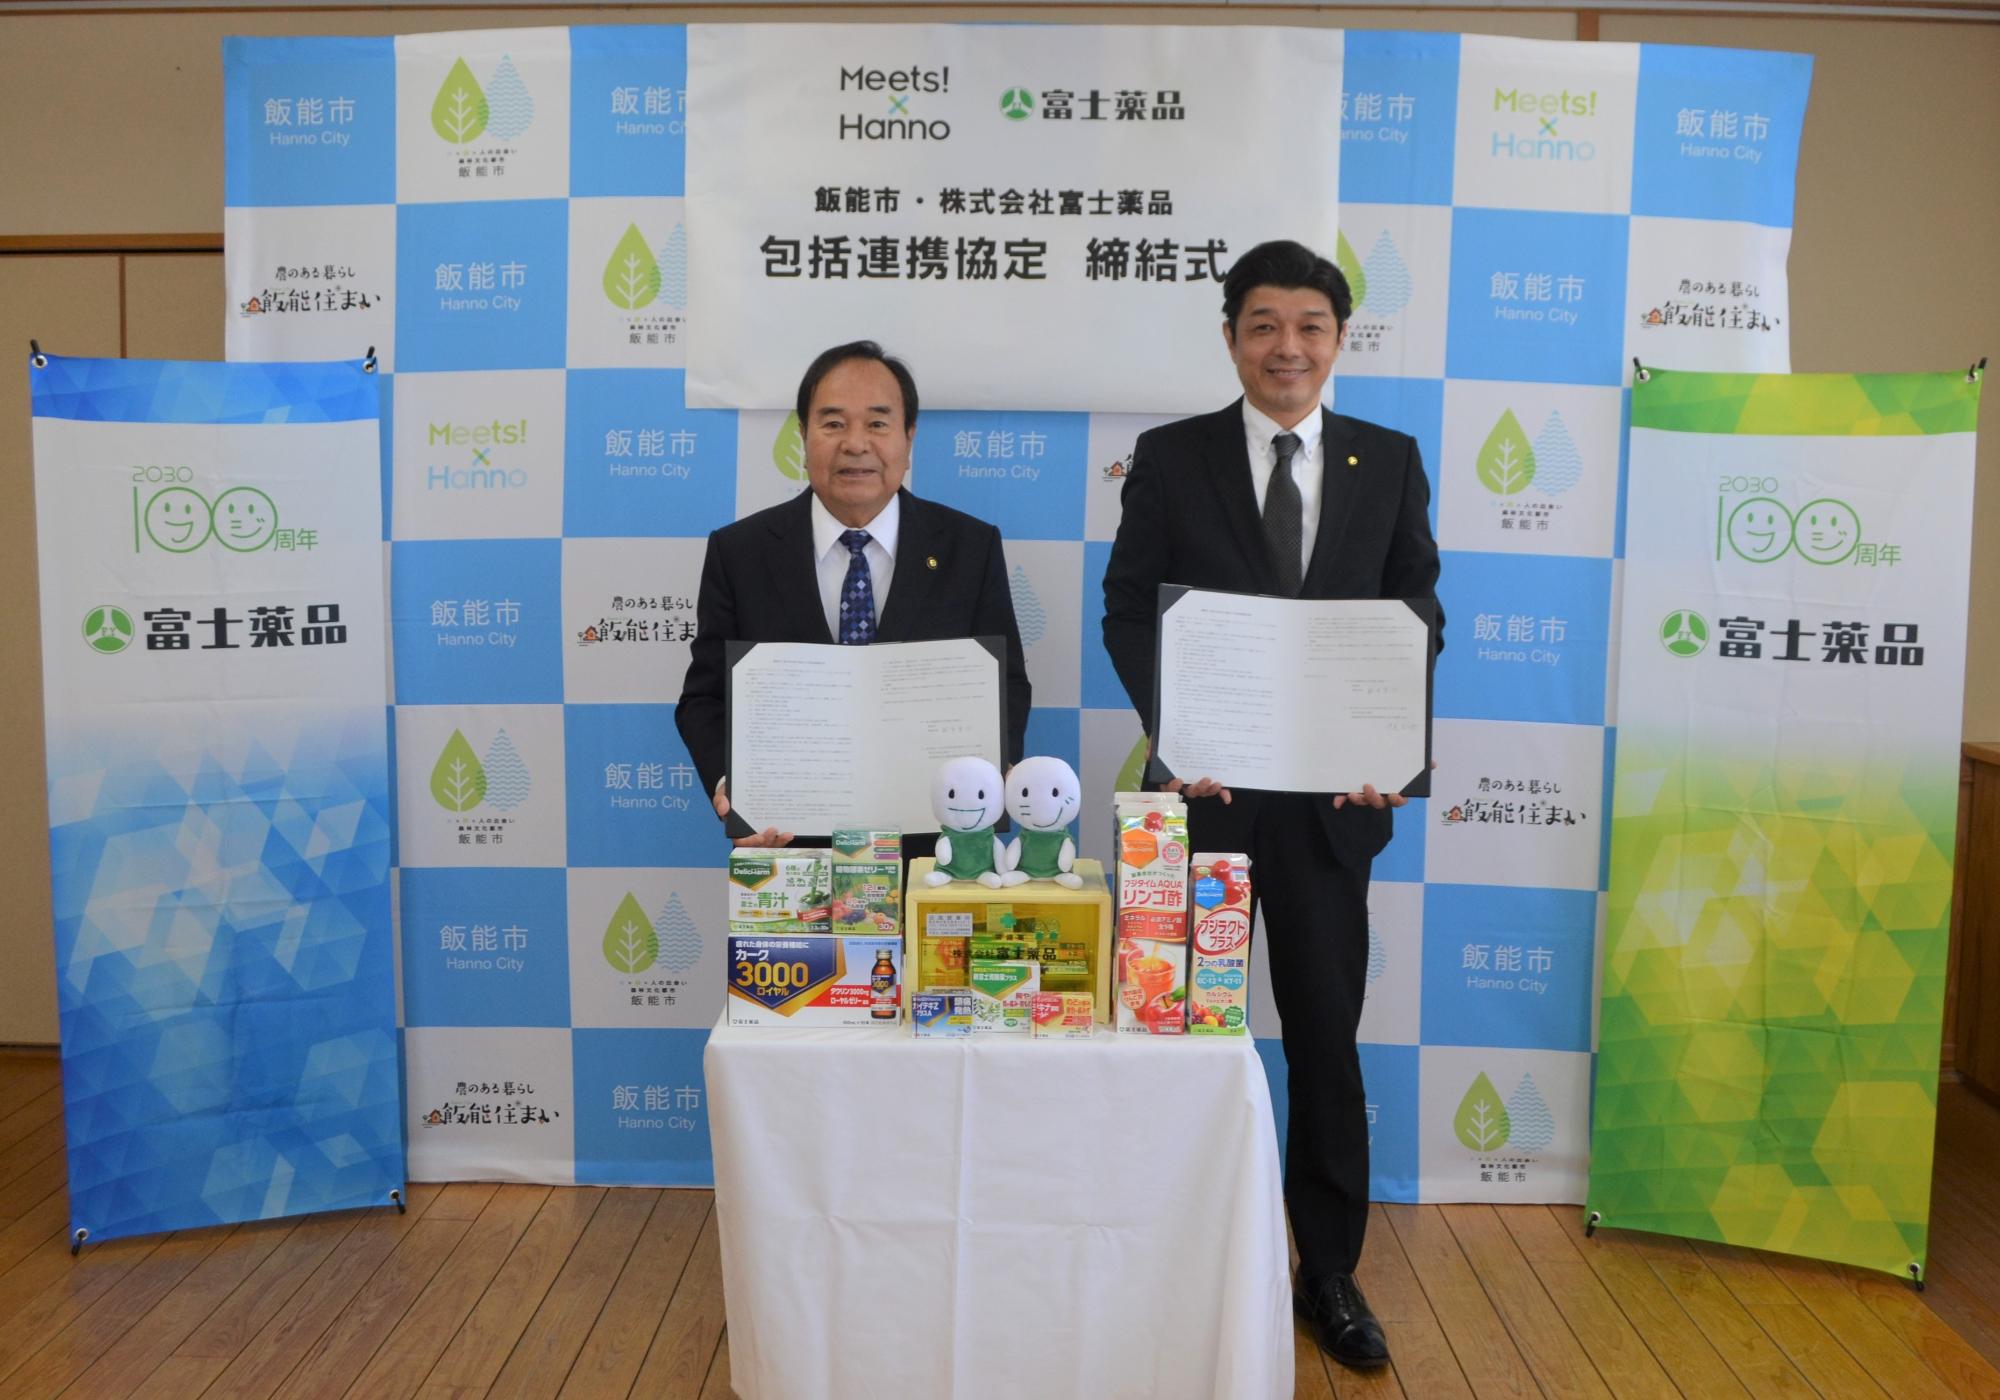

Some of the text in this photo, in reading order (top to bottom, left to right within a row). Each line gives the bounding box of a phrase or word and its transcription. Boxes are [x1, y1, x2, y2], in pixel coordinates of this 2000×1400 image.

[840, 65, 950, 93] Meets!
[264, 97, 356, 125] 飯能市
[1041, 88, 1186, 121] 富士薬品
[1492, 88, 1598, 117] Meets!
[616, 121, 665, 135] Hanno
[839, 113, 951, 141] Hanno
[1676, 107, 1771, 142] 飯能市
[269, 130, 350, 147] Hanno City
[1379, 127, 1409, 144] City
[1491, 132, 1596, 162] Hanno
[1680, 142, 1762, 164] Hanno City
[458, 166, 505, 177] 飯能市
[760, 235, 1228, 283] 包括連携協定 締結式
[434, 262, 528, 291] 飯能市
[1490, 272, 1586, 304] 飯能市
[440, 294, 522, 313] Hanno City
[1495, 306, 1578, 326] Hanno City
[629, 333, 677, 345] 飯能市
[428, 419, 528, 446] Meets!
[604, 429, 698, 458] 飯能市
[953, 430, 1048, 460] 飯能市
[132, 466, 194, 483] 2030
[427, 465, 528, 491] Hanno
[609, 463, 691, 480] Hanno City
[958, 464, 1041, 481] Hanno City
[1719, 475, 1779, 493] 2030
[1501, 518, 1550, 531] 飯能市
[430, 598, 521, 627] 飯能市
[143, 603, 348, 651] 富士薬品
[598, 617, 697, 643] 飯能住ま
[1473, 613, 1568, 644] 飯能市
[437, 632, 517, 648] Hanno City
[1718, 615, 1925, 666] 富士薬品
[1478, 647, 1561, 667] Hanno City
[604, 762, 696, 791] 飯能市
[610, 795, 690, 812] Hanno City
[458, 834, 505, 845] 飯能市
[1157, 880, 1183, 890] AQUA
[1123, 889, 1184, 907] リンゴ酢
[1200, 920, 1246, 935] フジラクト
[440, 924, 529, 952] 飯能市
[1209, 936, 1234, 948] プラス
[446, 957, 525, 973] Hanno City
[735, 949, 769, 961] カーク
[1460, 943, 1555, 975] 飯能市
[735, 961, 810, 988] 3000
[756, 986, 790, 997] ロイヤル
[1466, 975, 1548, 995] Hanno City
[630, 995, 678, 1007] 飯能市
[611, 1084, 702, 1112] 飯能市
[617, 1116, 697, 1133] Hanno City
[1480, 1172, 1527, 1183] 飯能市
